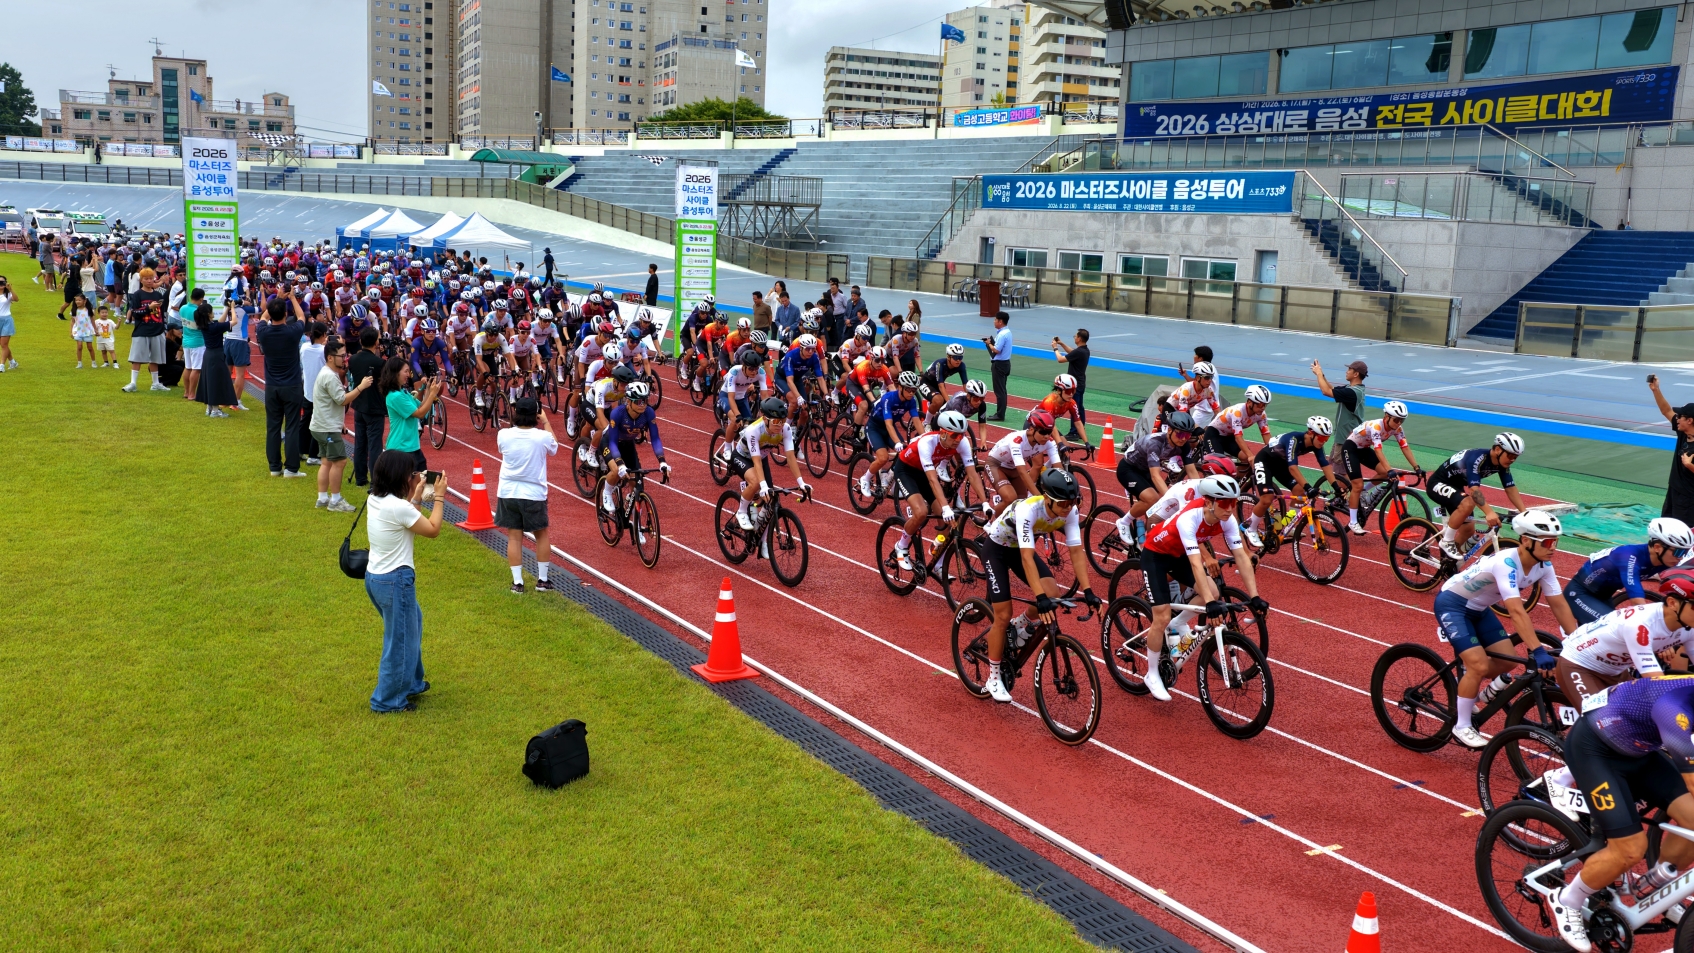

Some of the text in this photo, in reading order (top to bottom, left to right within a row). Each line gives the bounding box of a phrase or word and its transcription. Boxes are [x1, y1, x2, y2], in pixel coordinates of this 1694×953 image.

[964, 111, 1008, 125] 금성고등학교
[1155, 88, 1613, 135] 2026 상상대로 음성 전국 사이클대회
[193, 147, 228, 158] 2026
[189, 160, 232, 171] 마스터즈
[196, 173, 227, 184] 사이클
[685, 174, 711, 183] 2026
[191, 185, 234, 196] 음성투어
[682, 184, 713, 194] 마스터즈
[1015, 178, 1246, 200] 2026 마스터즈사이클 음성투어
[1249, 188, 1265, 196] 스포츠
[686, 196, 709, 205] 사이클
[681, 205, 713, 216] 음성투어
[208, 220, 226, 228] 음성군
[1287, 439, 1295, 463] MAXXIS
[1472, 454, 1485, 475] MAXXIS
[1023, 519, 1031, 543] SMITH
[1464, 544, 1481, 561] ENGINE
[1627, 554, 1637, 586] SEVENHILLS
[1576, 637, 1598, 652] CYC.DUO
[1563, 709, 1575, 722] 41
[1568, 790, 1583, 808] 75
[1638, 870, 1694, 914] SCOTT
